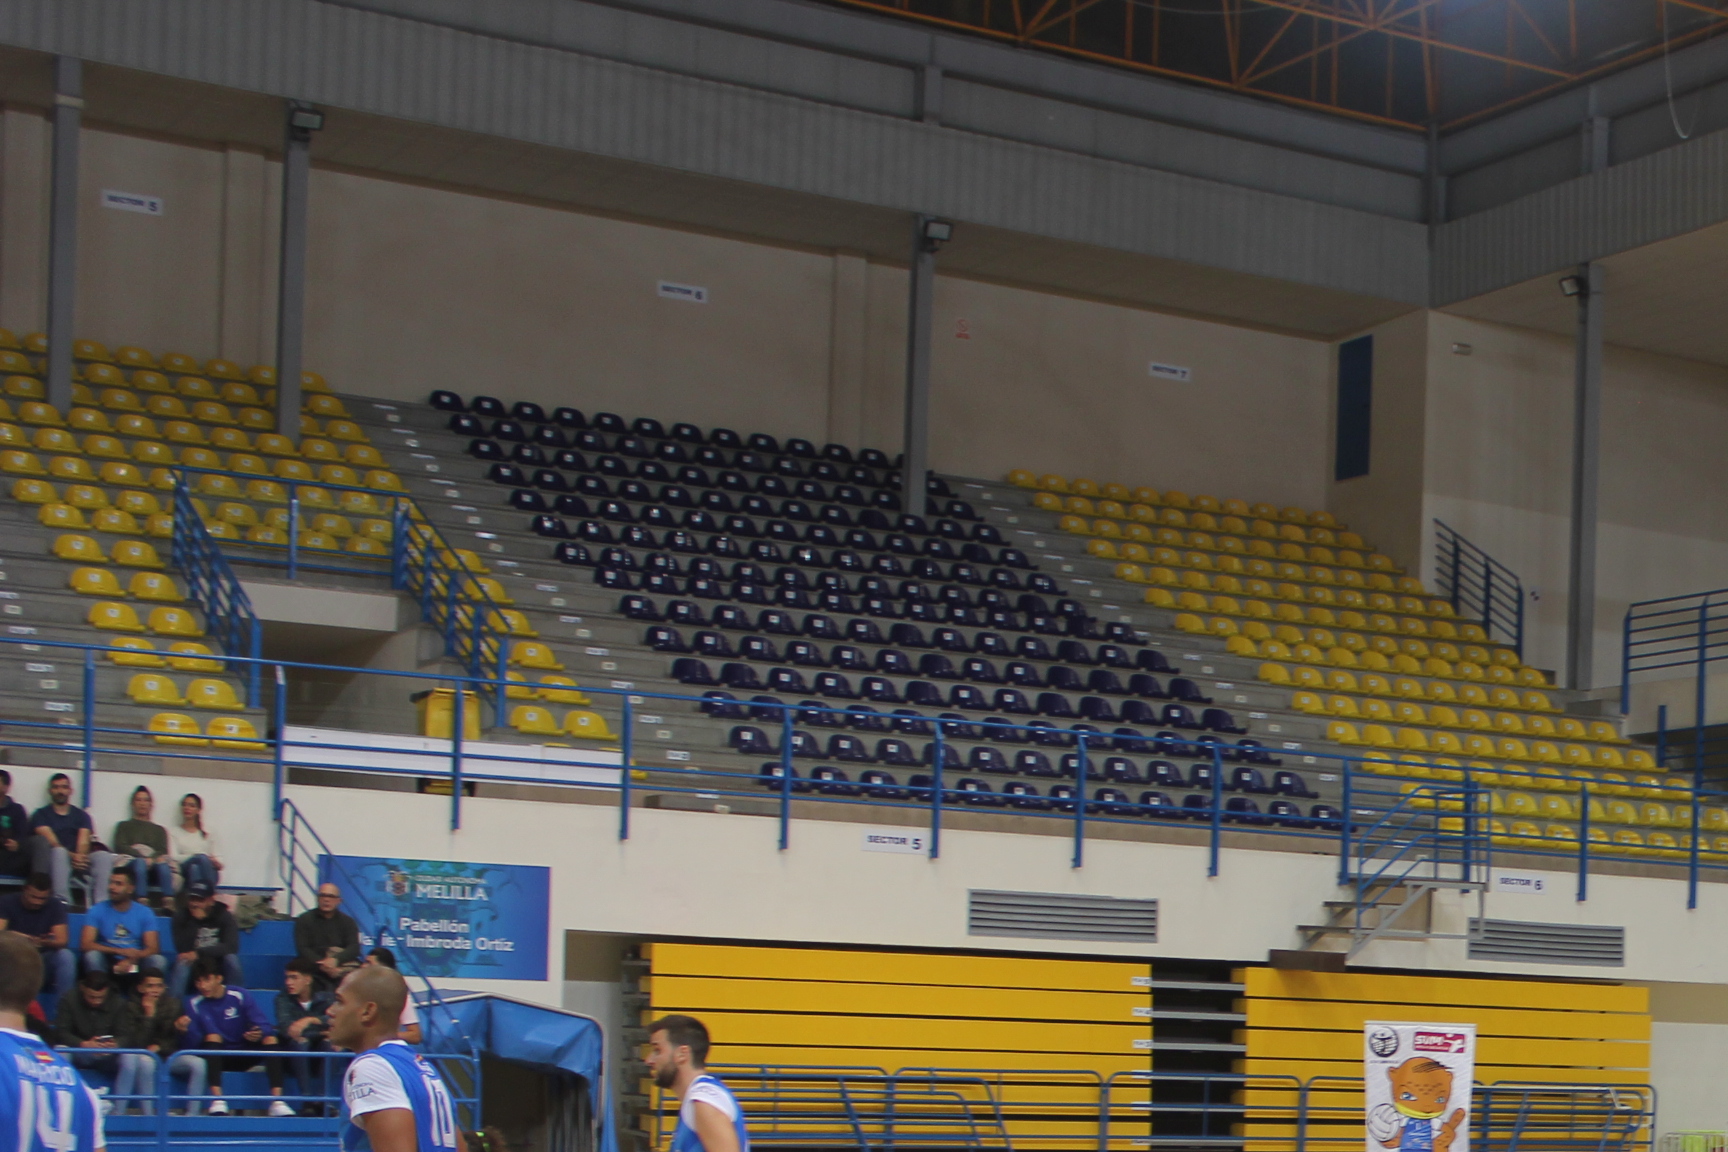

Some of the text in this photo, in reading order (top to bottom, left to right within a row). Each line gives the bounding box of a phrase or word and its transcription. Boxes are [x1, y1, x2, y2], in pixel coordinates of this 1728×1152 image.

[867, 835, 922, 850] SECTOR 5
[1499, 876, 1543, 891] SECTOR 6
[415, 883, 489, 901] MELILLA
[400, 917, 469, 933] Pabellón
[406, 936, 472, 950] Imbroda
[422, 1074, 457, 1148] 10
